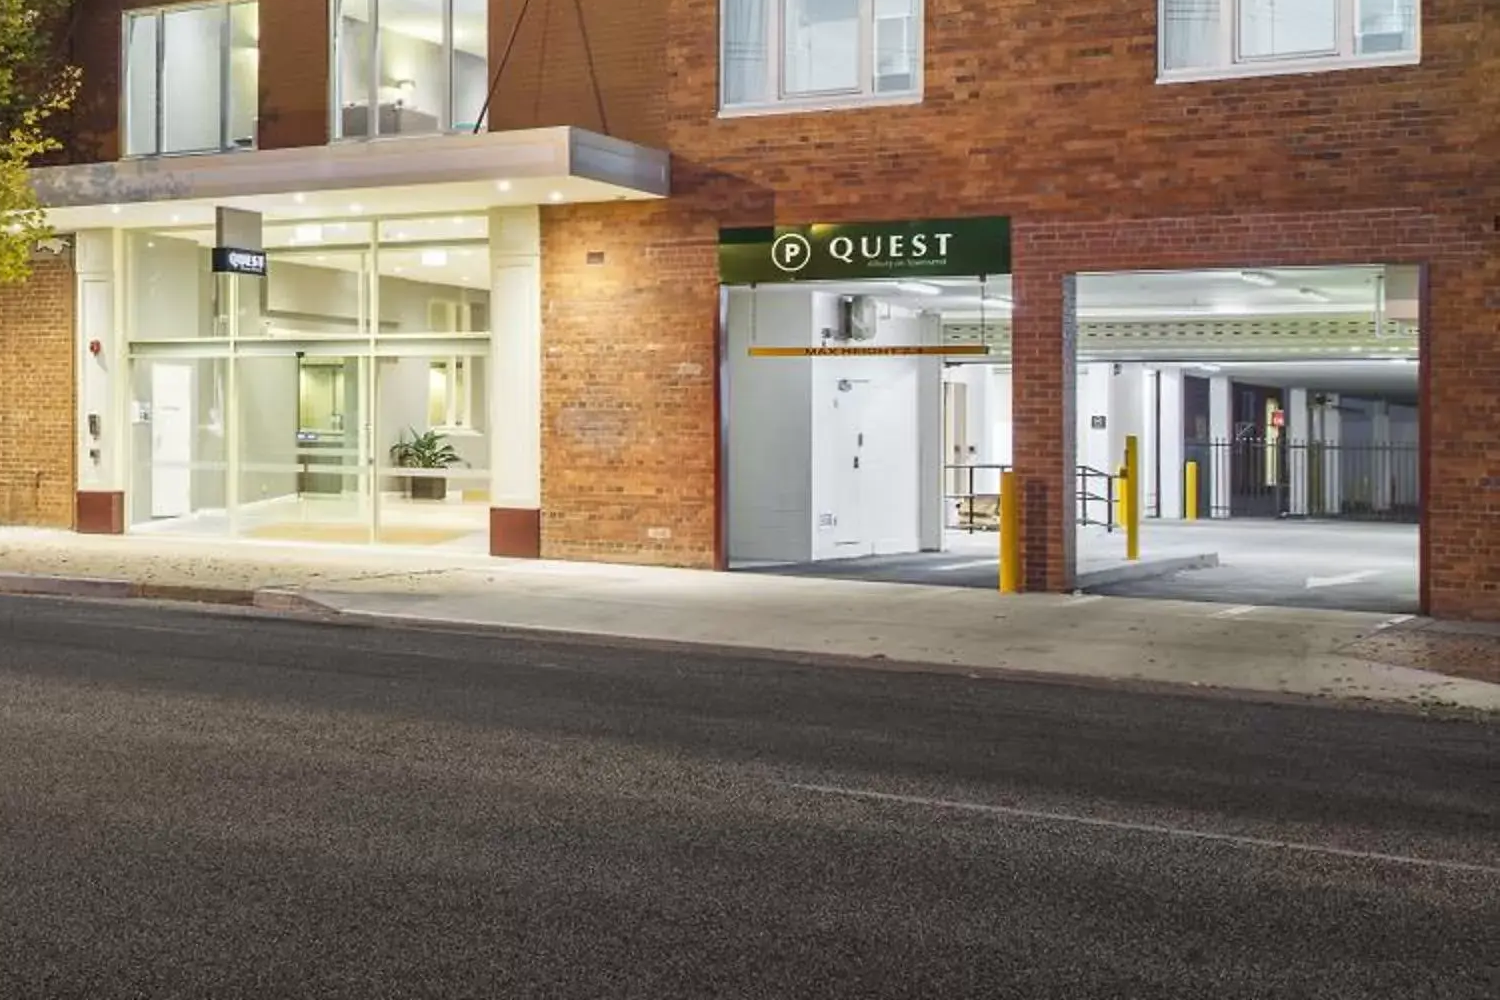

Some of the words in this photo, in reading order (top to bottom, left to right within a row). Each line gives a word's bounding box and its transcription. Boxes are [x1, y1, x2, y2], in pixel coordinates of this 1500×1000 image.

[785, 243, 800, 263] P
[829, 233, 953, 263] QUEST
[228, 251, 265, 268] QUEST
[804, 347, 837, 356] MAX
